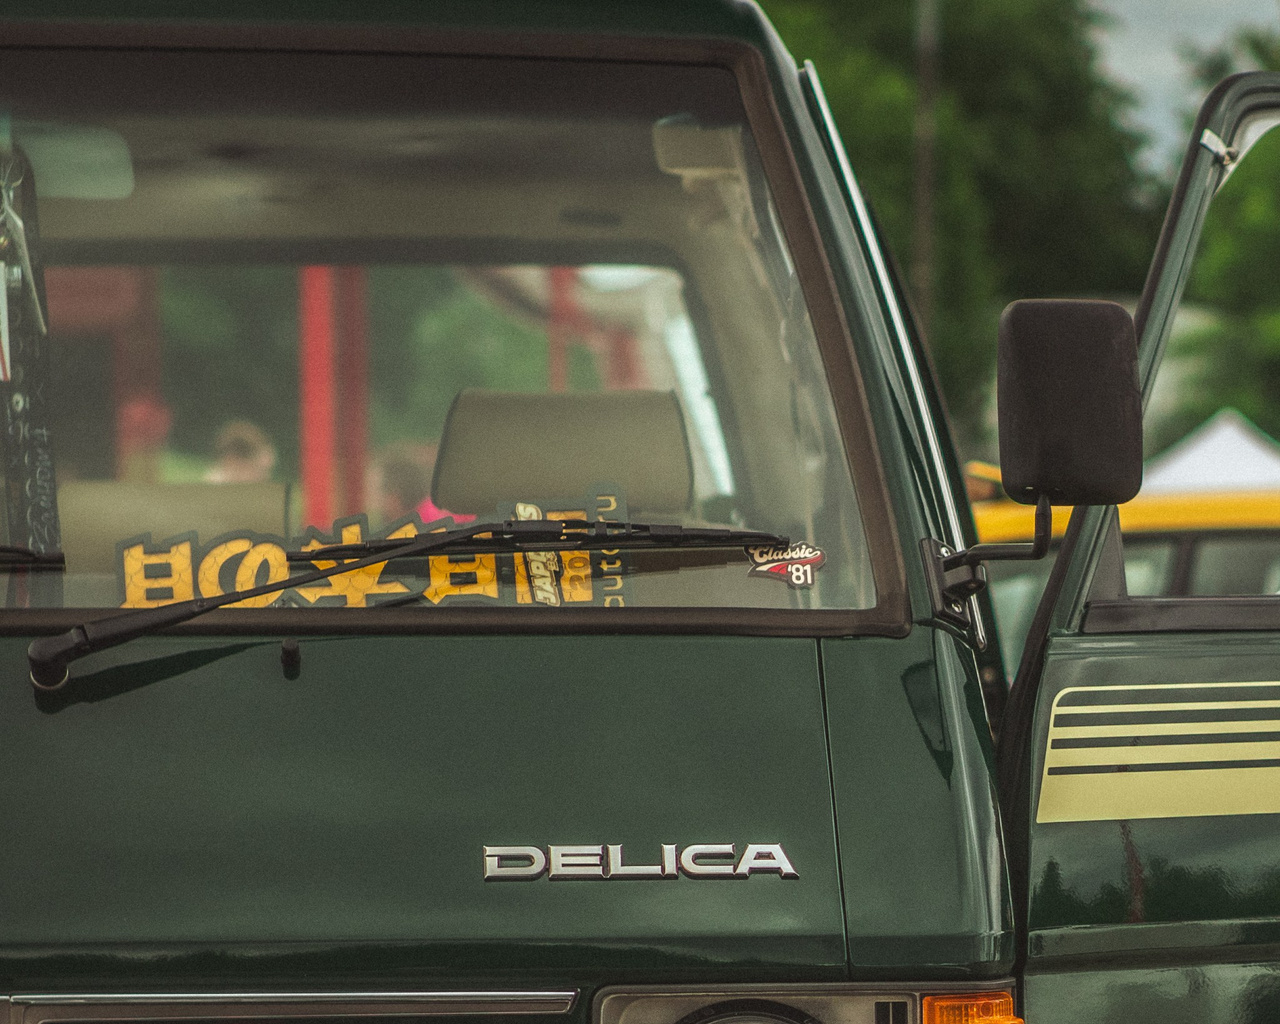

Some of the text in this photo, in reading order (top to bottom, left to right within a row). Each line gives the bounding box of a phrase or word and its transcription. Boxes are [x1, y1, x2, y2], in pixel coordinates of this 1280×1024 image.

[749, 545, 821, 563] Classic
[787, 564, 812, 585] '81
[483, 843, 800, 880] DELICA
